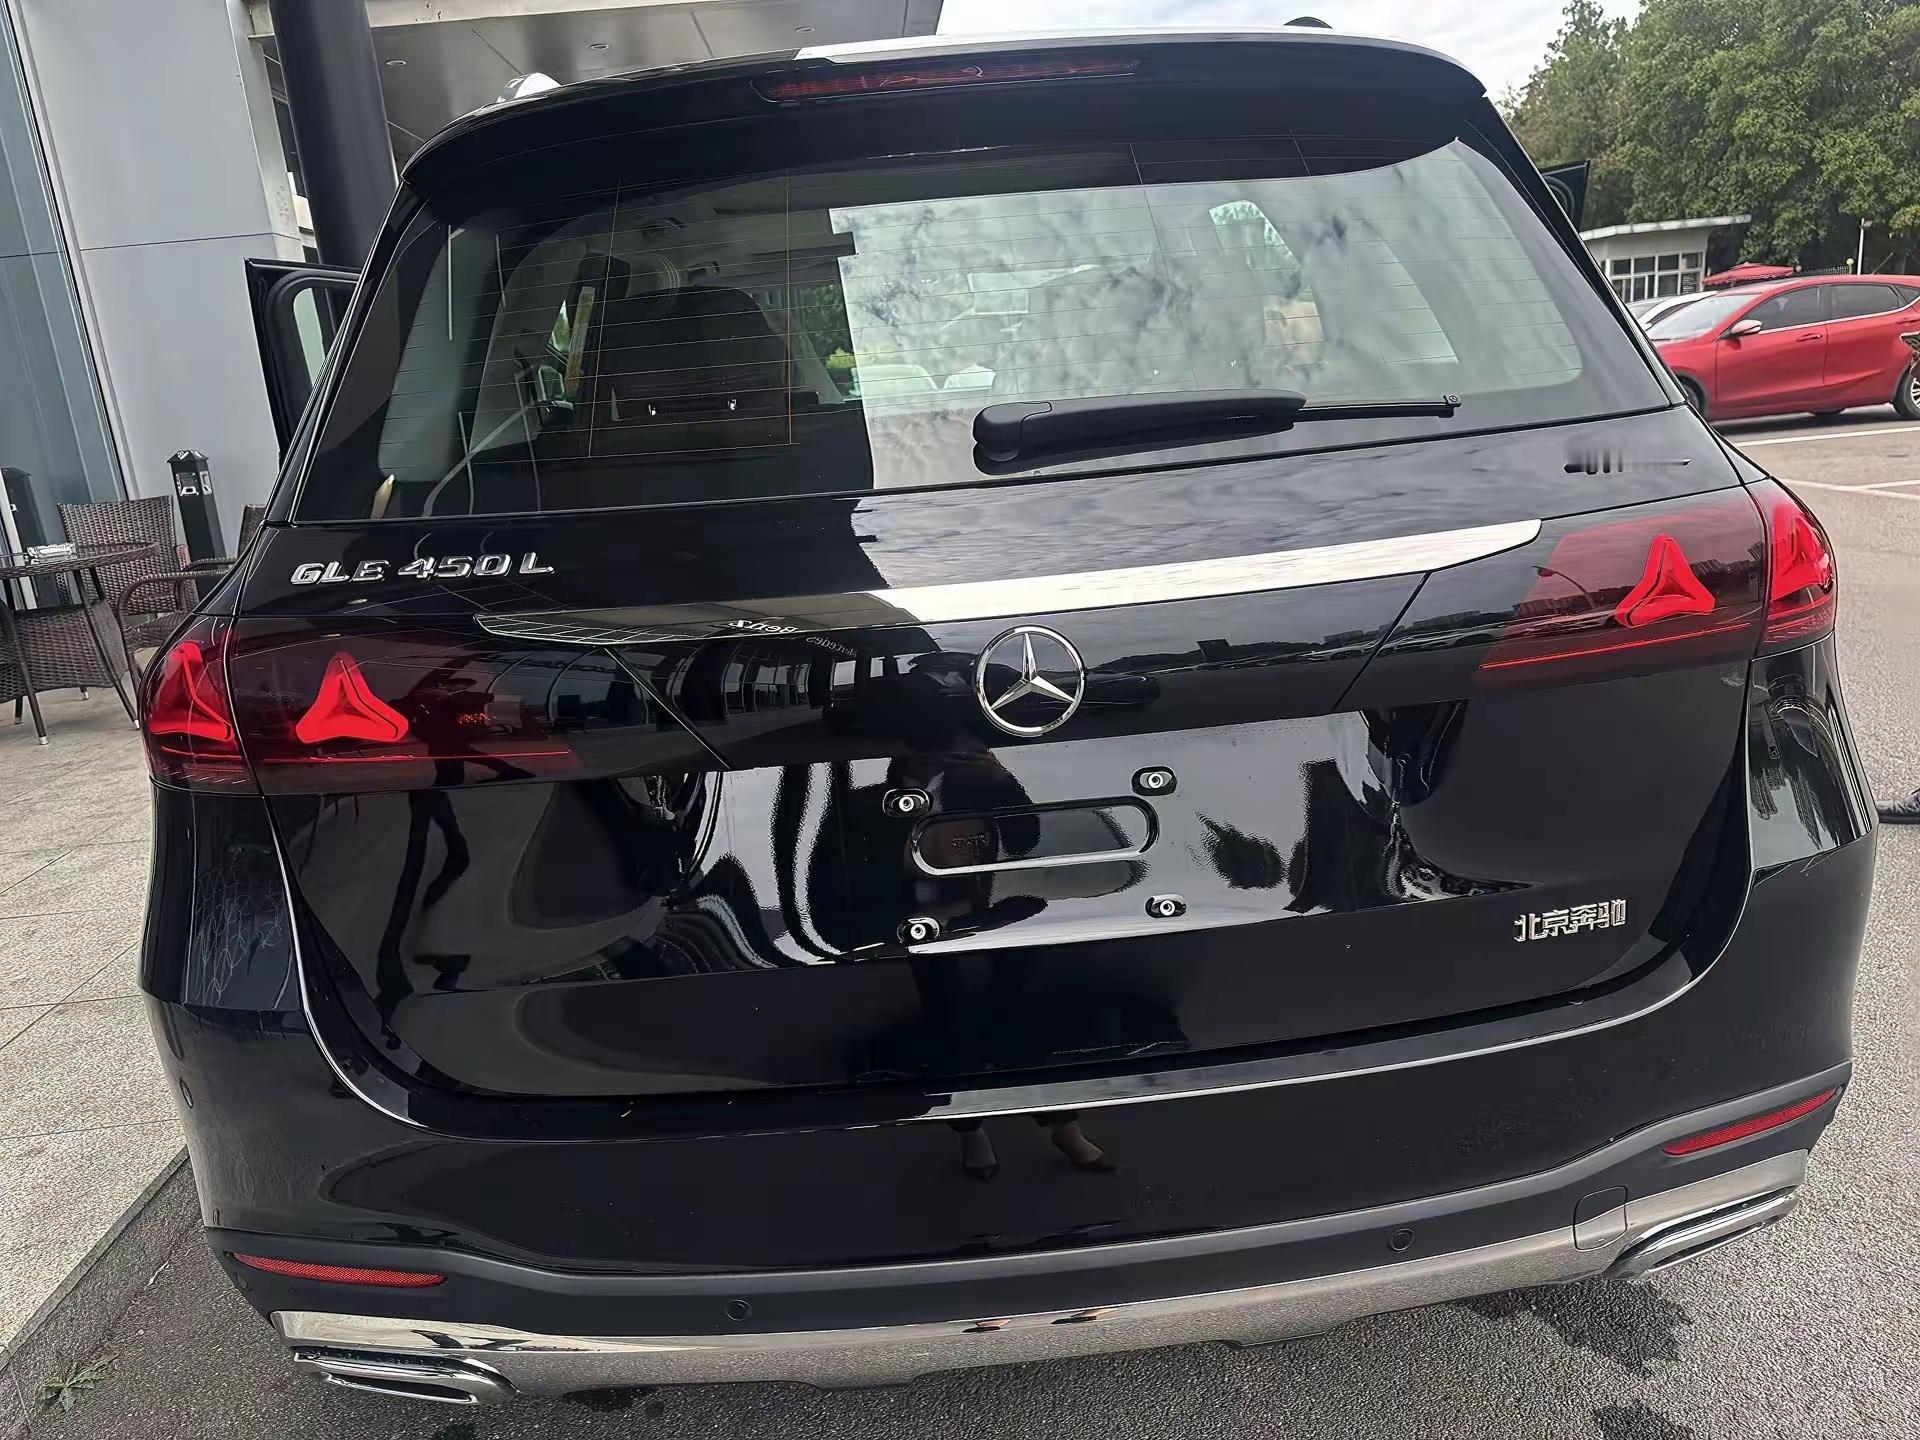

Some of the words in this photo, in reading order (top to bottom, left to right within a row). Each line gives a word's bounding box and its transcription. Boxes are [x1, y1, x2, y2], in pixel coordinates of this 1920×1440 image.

[290, 560, 391, 584] GLE
[398, 554, 512, 579] 450
[519, 552, 555, 575] L
[1513, 899, 1627, 941] 北京奔驰
